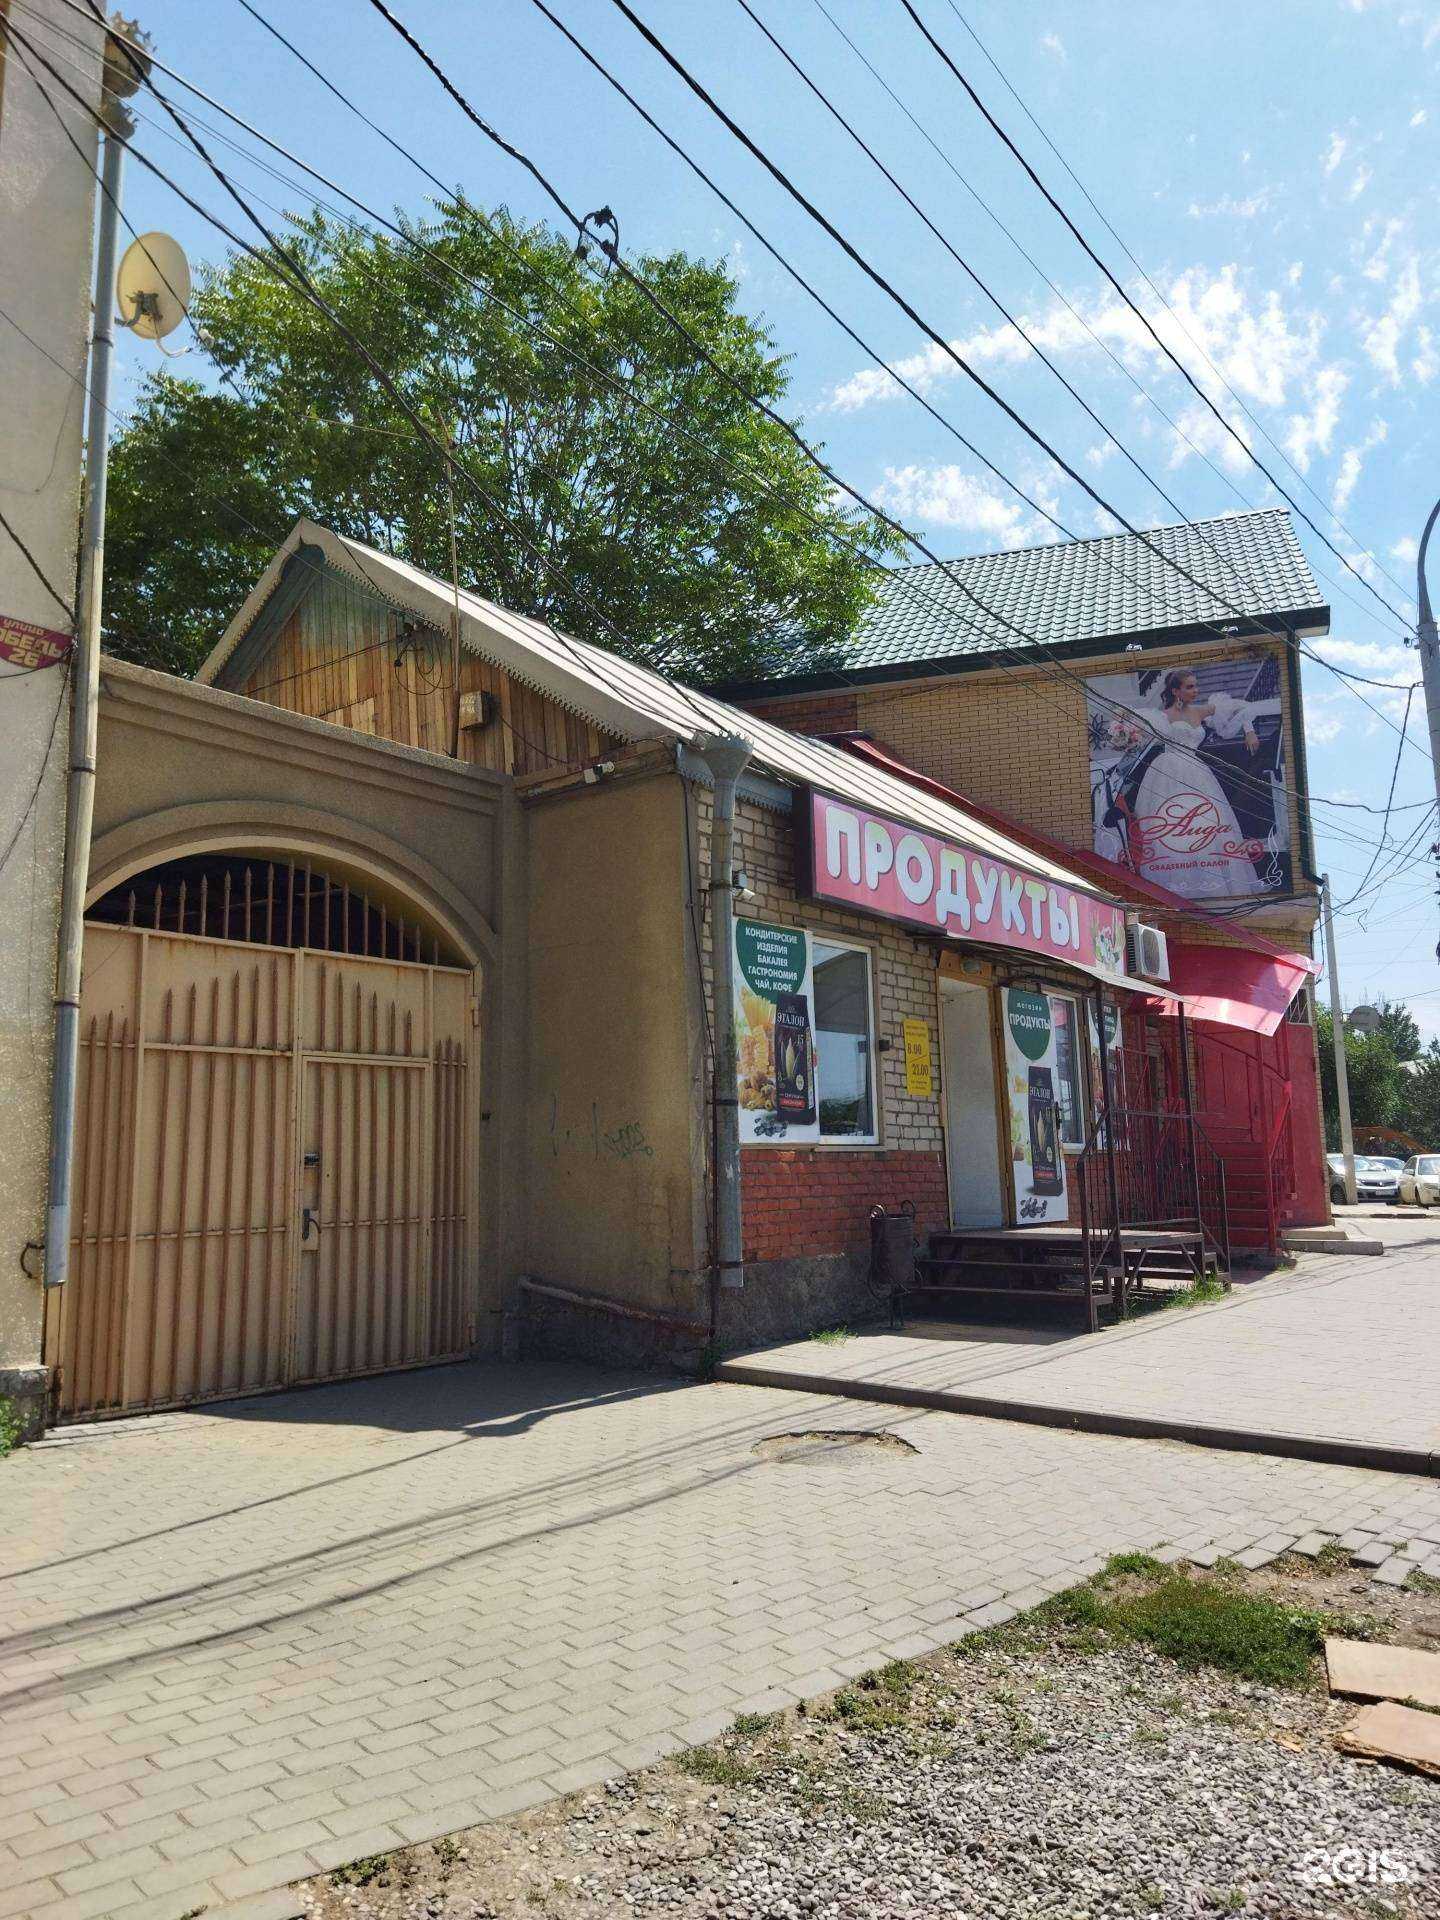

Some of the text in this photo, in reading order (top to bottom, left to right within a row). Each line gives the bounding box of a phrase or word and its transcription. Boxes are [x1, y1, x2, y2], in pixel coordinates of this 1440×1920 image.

[8, 648, 39, 668] 26
[1149, 860, 1230, 871] СВАДЕБНЫЙ САЛОН
[825, 805, 1080, 950] ПРОДУКТЫ
[745, 927, 798, 944] КОНДИТЕРСКИЕ
[757, 942, 788, 955] ИЗДЕЛИЯ
[757, 954, 789, 967] БАКАЛЕЯ
[747, 966, 798, 981] ГАСТРОНОМИЯ
[755, 979, 793, 992] ЧАЙ, КОФЕ
[1009, 1013, 1051, 1030] ПРОДУКТЫ
